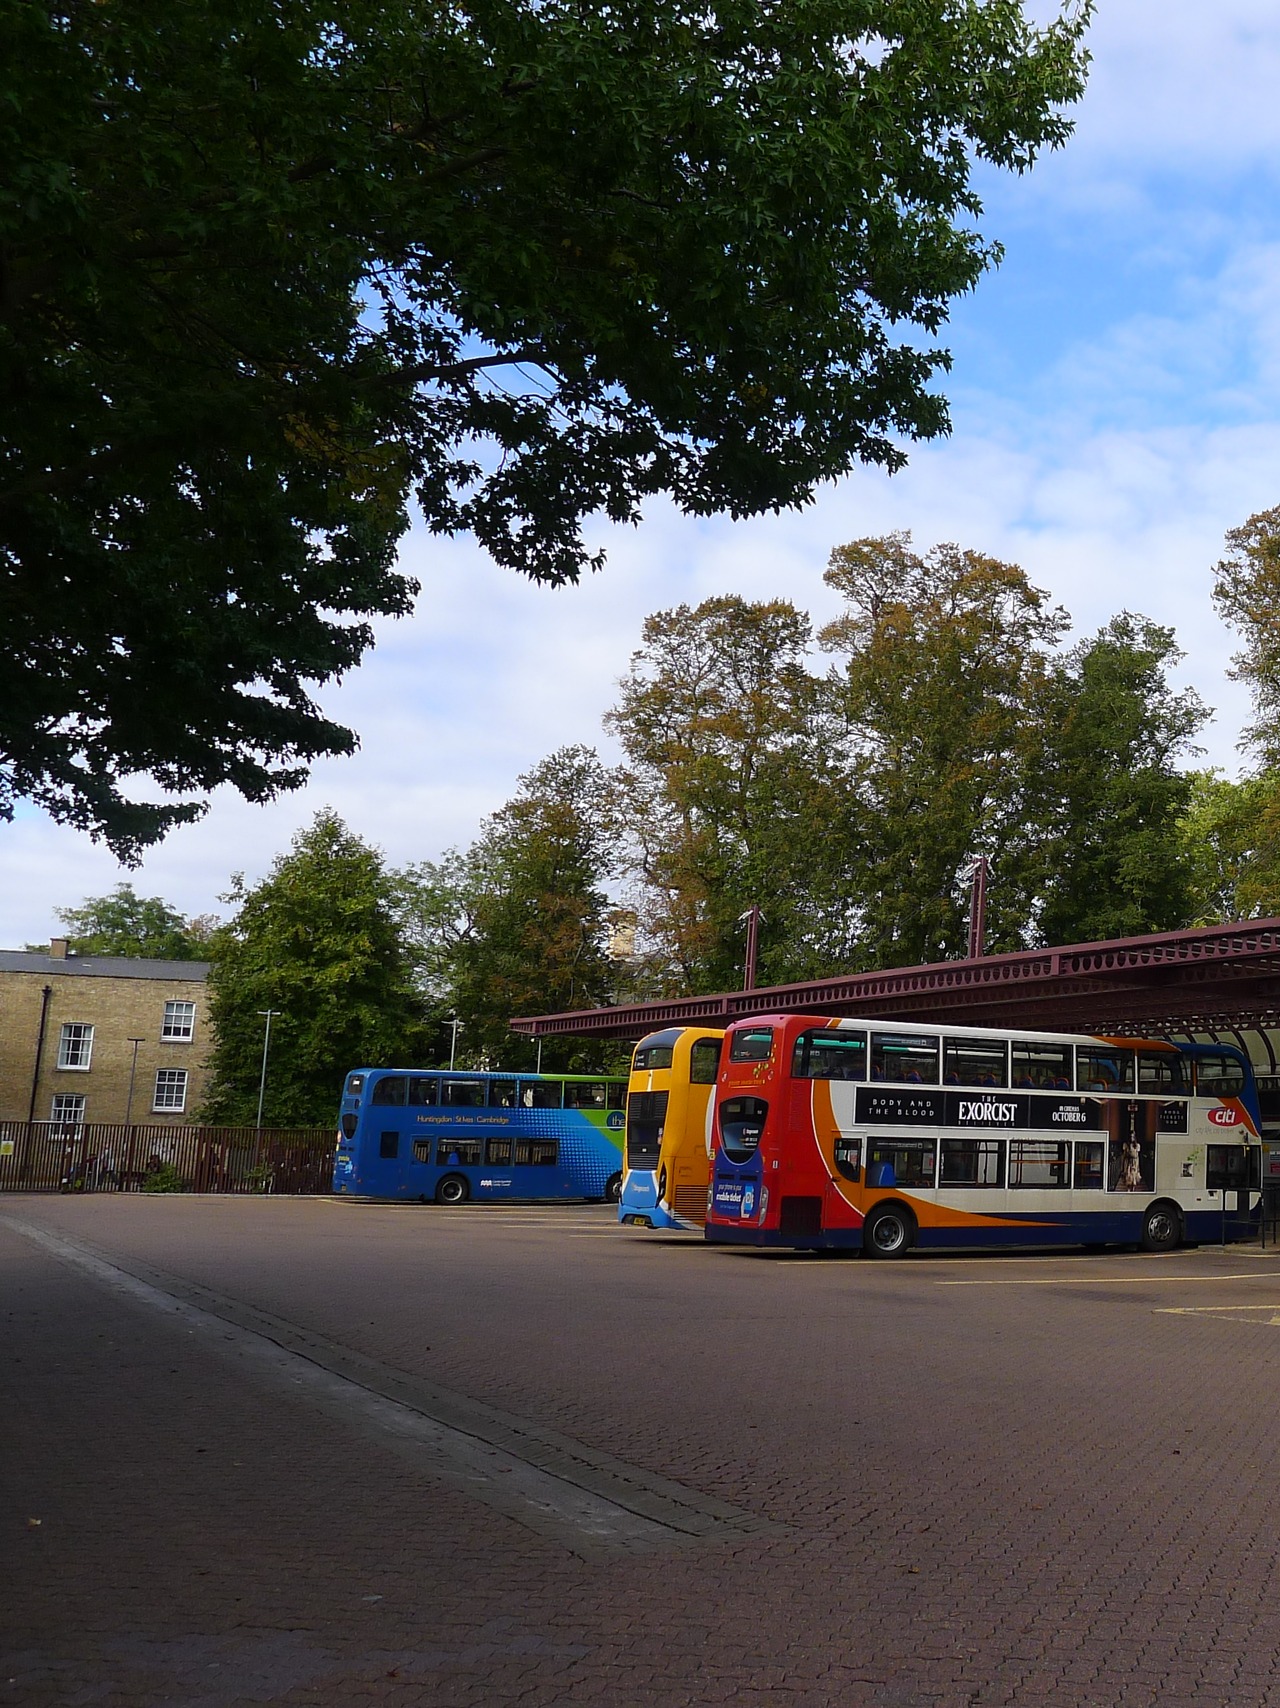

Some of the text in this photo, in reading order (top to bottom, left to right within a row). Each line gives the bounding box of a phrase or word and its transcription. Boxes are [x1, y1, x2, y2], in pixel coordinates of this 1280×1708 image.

[872, 1098, 902, 1107] BODY
[981, 1095, 997, 1103] THE
[868, 1107, 935, 1117] THE BLOOD
[958, 1101, 1018, 1122] EXORCIST
[1052, 1111, 1087, 1123] OCTOBER 6
[1215, 1109, 1236, 1124] citi
[416, 1114, 453, 1124] Huntingdon
[476, 1115, 510, 1125] Cambridge
